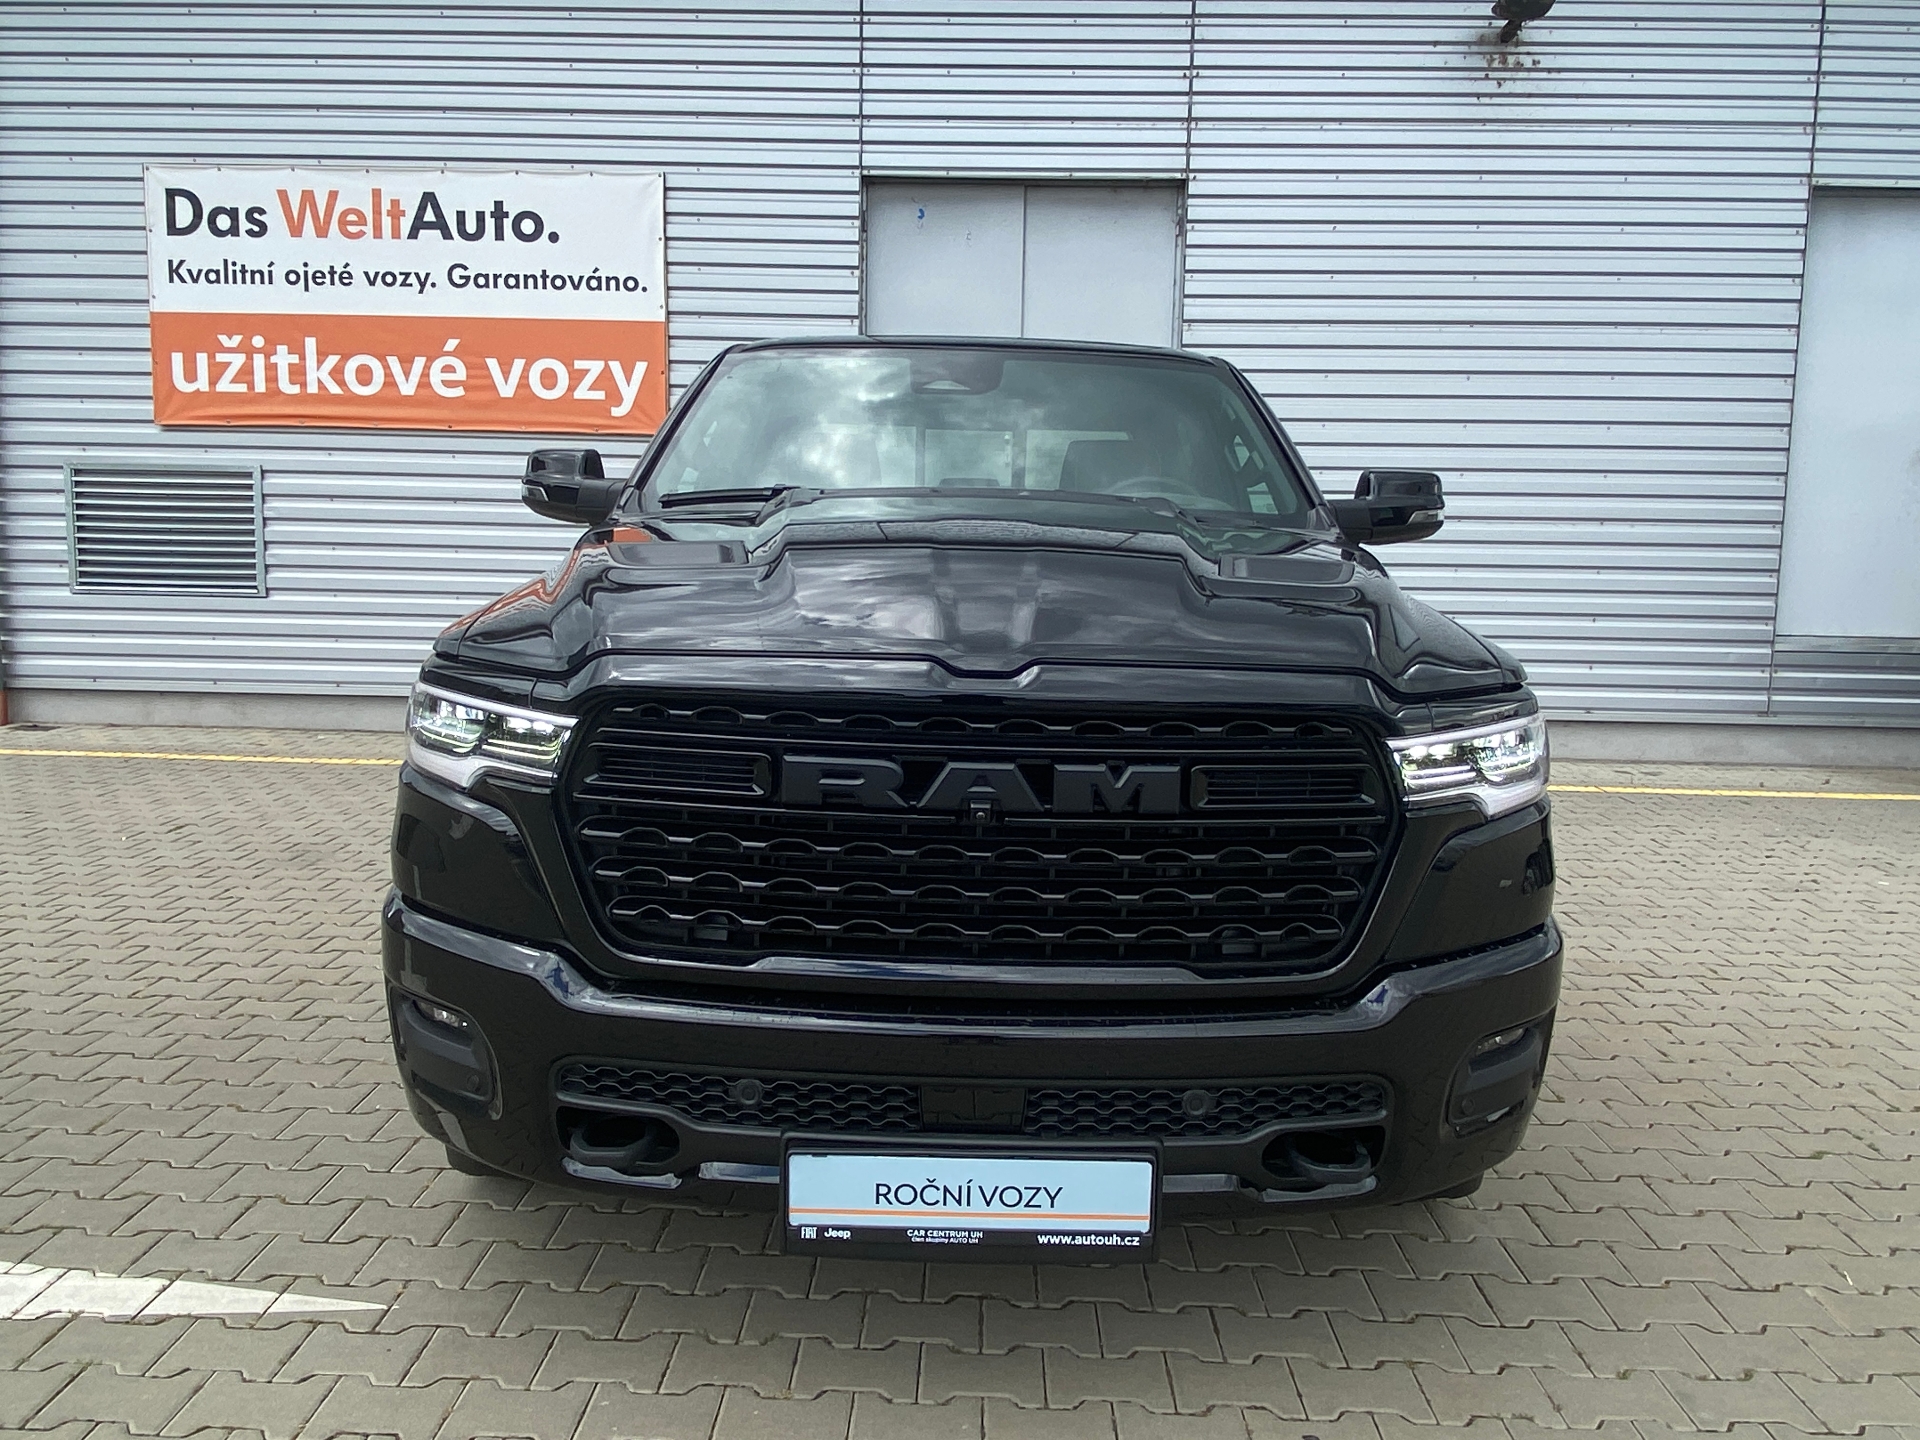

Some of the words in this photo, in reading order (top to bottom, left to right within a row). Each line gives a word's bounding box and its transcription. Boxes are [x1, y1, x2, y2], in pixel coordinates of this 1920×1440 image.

[164, 187, 268, 239] Das
[277, 188, 560, 244] WeltAuto.
[167, 258, 274, 286] Kvalitní
[285, 261, 354, 293] ojeté
[363, 269, 437, 295] vozy.
[447, 263, 648, 294] Garantováno.
[170, 334, 467, 398] užitkové
[482, 356, 648, 417] vozy
[781, 754, 1180, 814] RAM
[875, 1178, 974, 1207] ROČNÍ
[977, 1185, 1063, 1209] VOZY
[801, 1226, 817, 1239] FIAT
[824, 1227, 851, 1240] Jeep
[907, 1229, 925, 1237] CAR
[927, 1230, 968, 1238] CENTRUM
[970, 1231, 983, 1239] UH
[1037, 1233, 1140, 1247] www.autouh.cz
